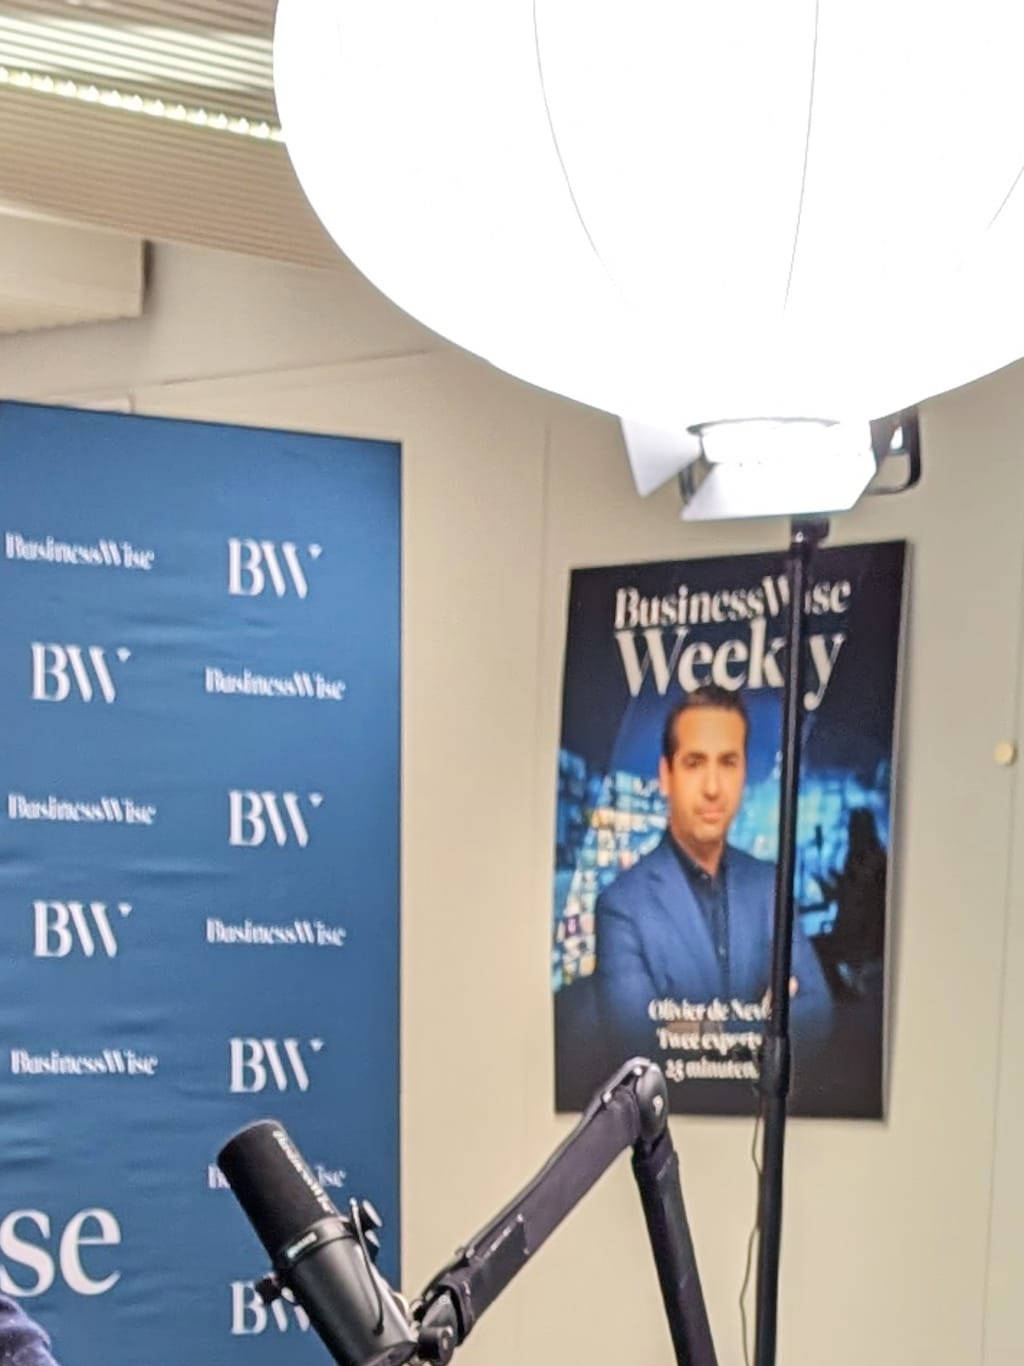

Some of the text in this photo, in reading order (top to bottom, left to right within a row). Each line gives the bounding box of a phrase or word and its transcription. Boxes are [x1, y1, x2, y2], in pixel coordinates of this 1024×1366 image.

[5, 532, 155, 570] BusinessWise
[228, 538, 322, 598] BW
[615, 576, 851, 628] BusinessWse
[31, 643, 131, 703] BW
[205, 667, 346, 700] BusinessWise
[614, 616, 845, 711] Weeky
[8, 793, 156, 825] BusinessWise
[229, 790, 323, 846] BW
[34, 900, 132, 957] BW
[206, 918, 346, 946] BusinessWise
[11, 1050, 158, 1074] BusinessWise
[230, 1038, 323, 1093] BW
